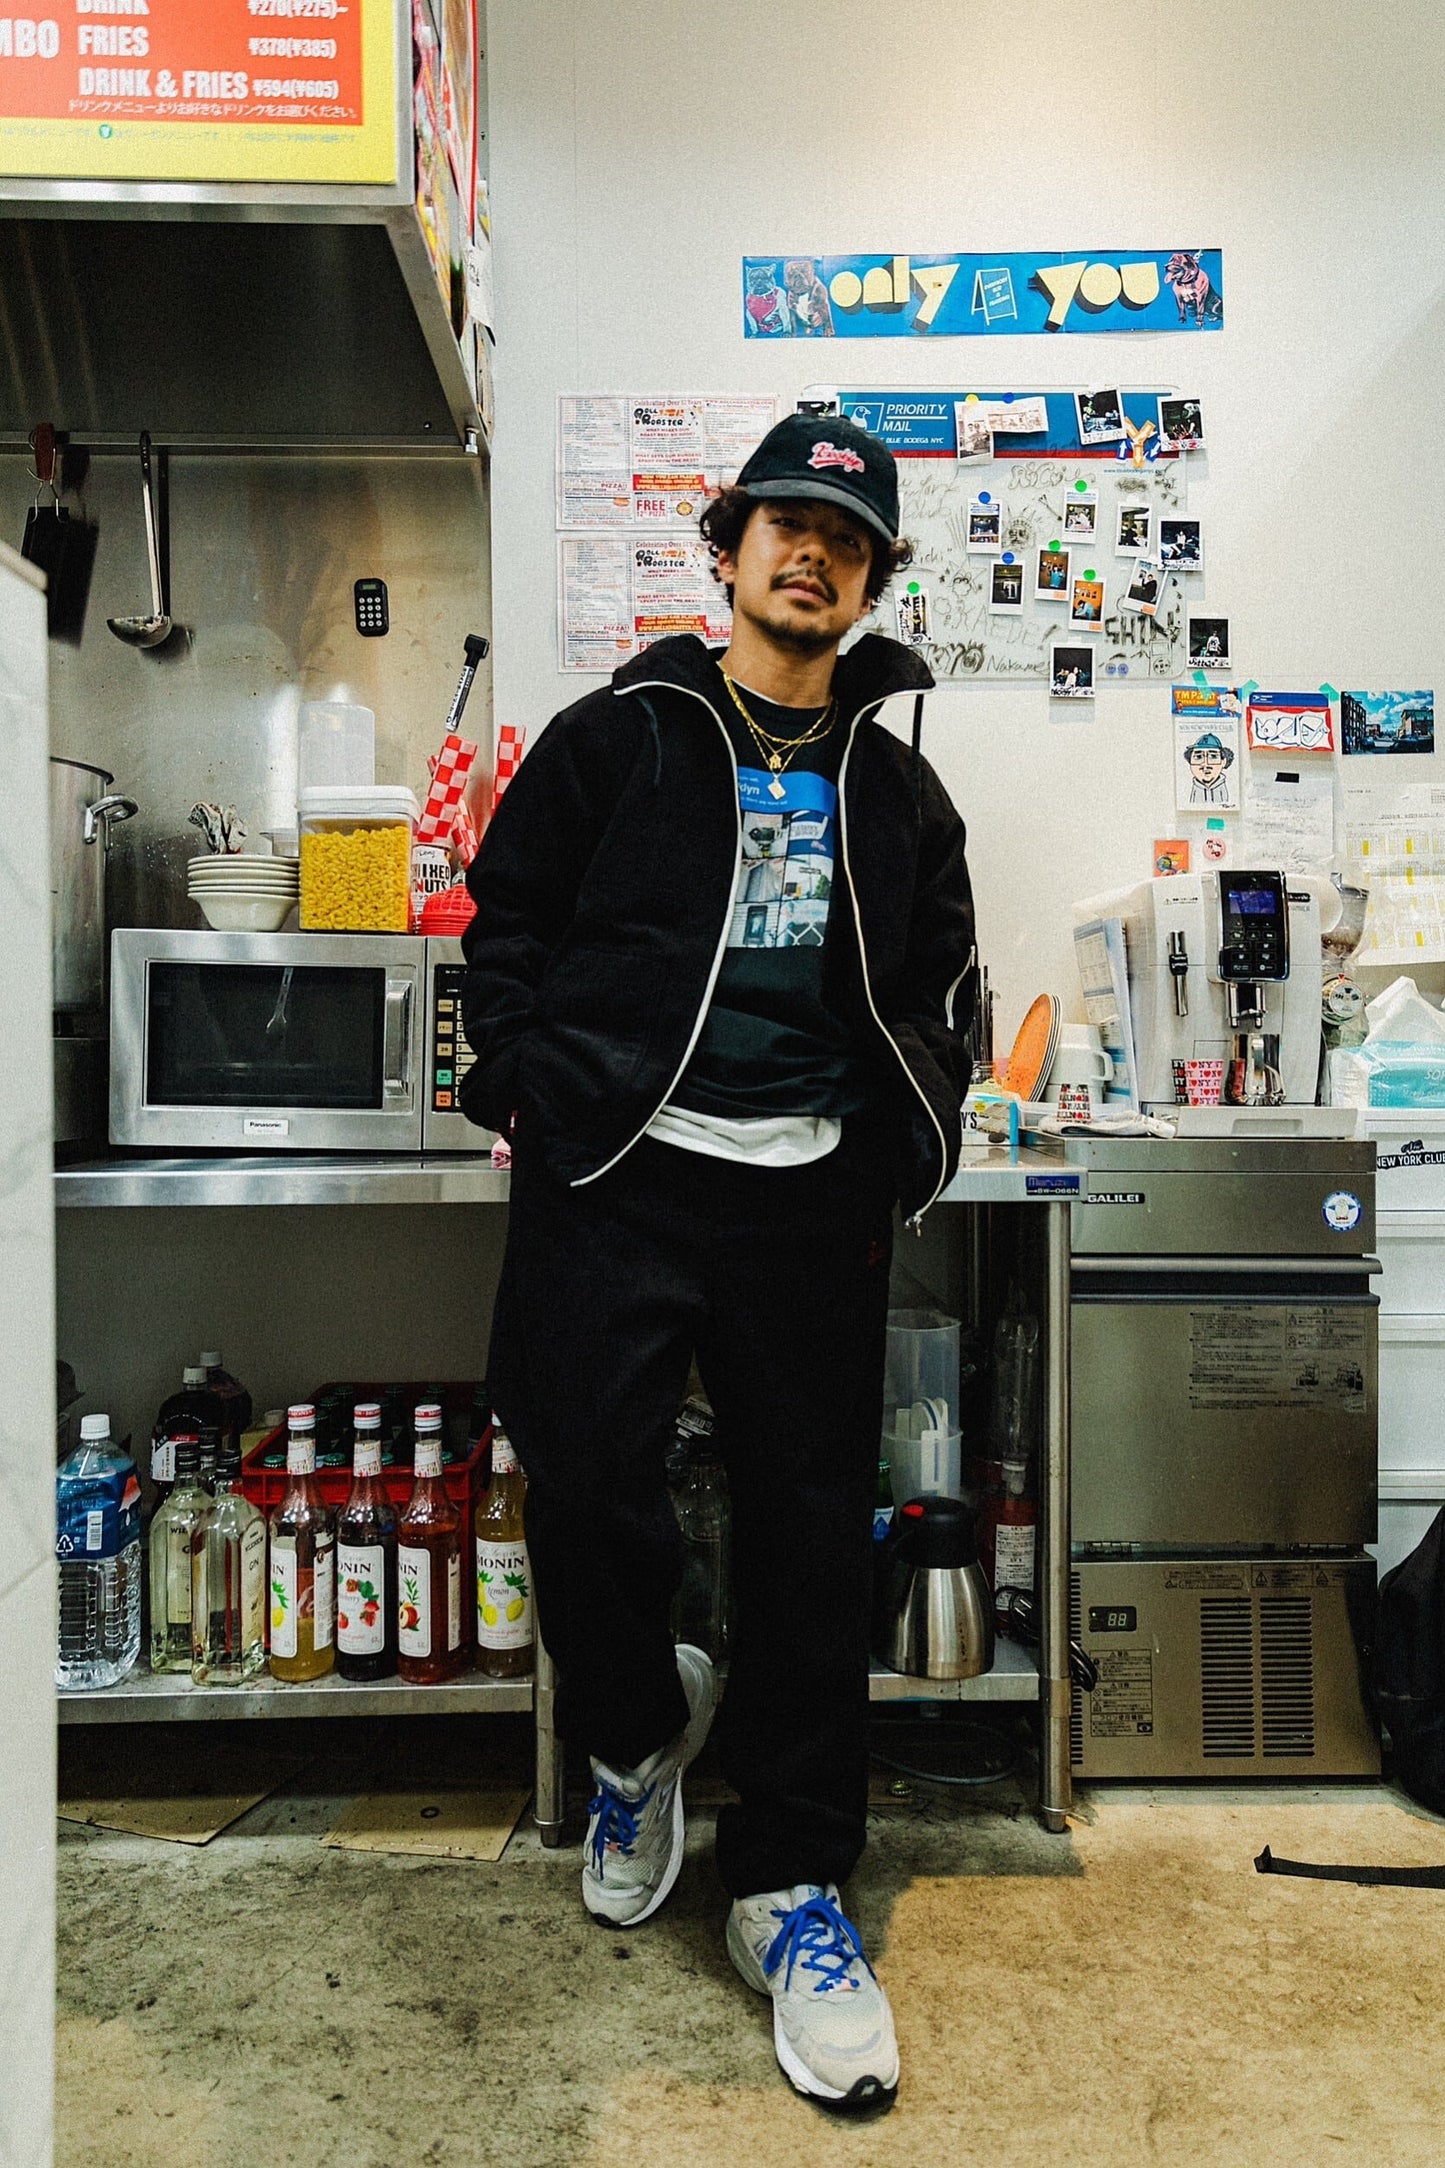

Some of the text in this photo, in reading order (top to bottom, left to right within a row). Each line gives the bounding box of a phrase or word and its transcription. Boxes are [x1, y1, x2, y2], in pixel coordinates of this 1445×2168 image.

[78, 25, 337, 59] FRIES ¥378(¥385)
[79, 68, 340, 100] DRINK & FRIES ¥594(¥605)
[886, 404, 947, 415] PRIORITY
[882, 421, 912, 432] MAIL
[637, 500, 666, 511] FREE
[1398, 1155, 1422, 1166] YORK
[1087, 1194, 1140, 1203] GALILEI
[477, 1556, 525, 1569] MONIN
[1107, 1613, 1127, 1626] 88
